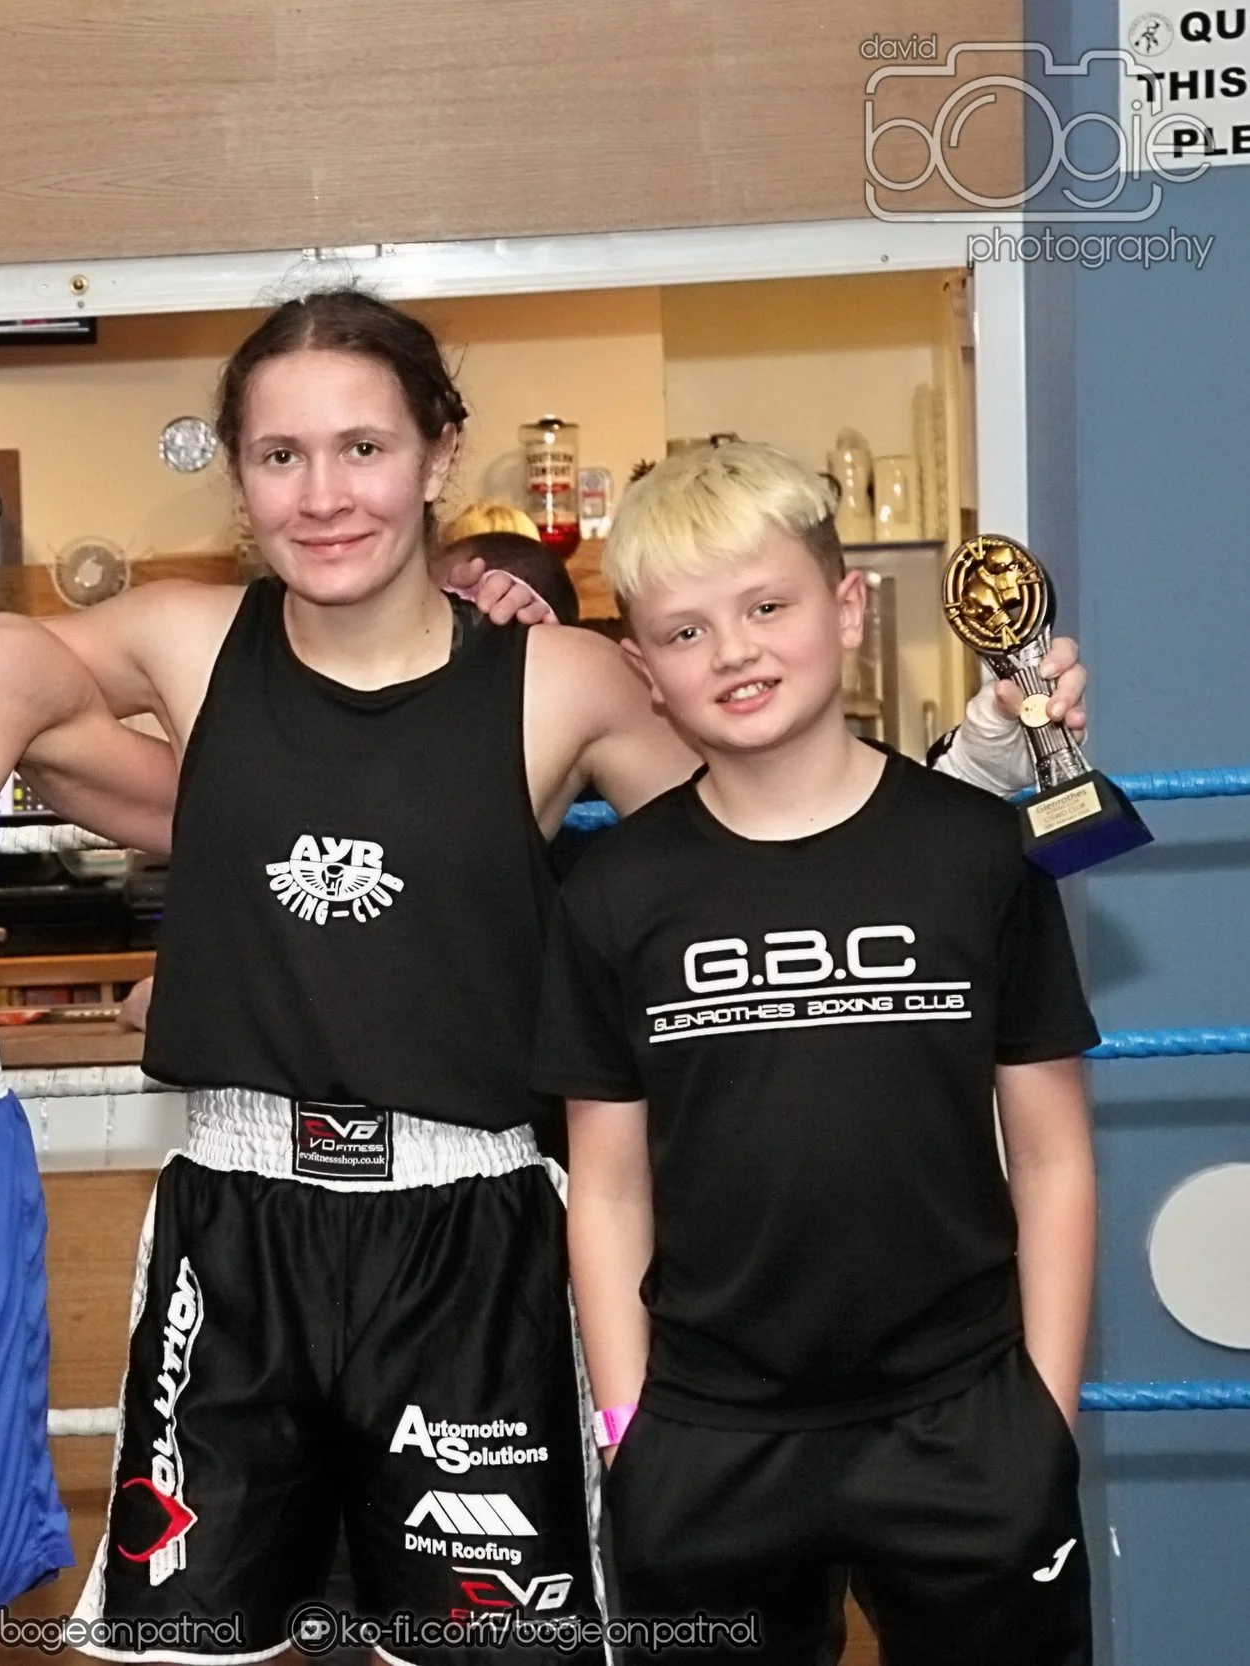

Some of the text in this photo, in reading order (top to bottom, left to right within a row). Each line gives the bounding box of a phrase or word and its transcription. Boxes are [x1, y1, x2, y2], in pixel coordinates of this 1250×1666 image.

[1180, 9, 1245, 42] QU
[1137, 67, 1247, 102] THIS
[1173, 125, 1250, 158] PLE
[526, 452, 573, 464] SOUTHERN
[290, 834, 384, 869] AYR
[684, 925, 916, 993] G.B.C
[654, 994, 965, 1033] GLENROTHES BOXING CLUB
[336, 1143, 385, 1152] FITNESS
[389, 1404, 528, 1459] Automotive
[435, 1437, 549, 1474] Solutions
[405, 1533, 523, 1566] DMM Roofing
